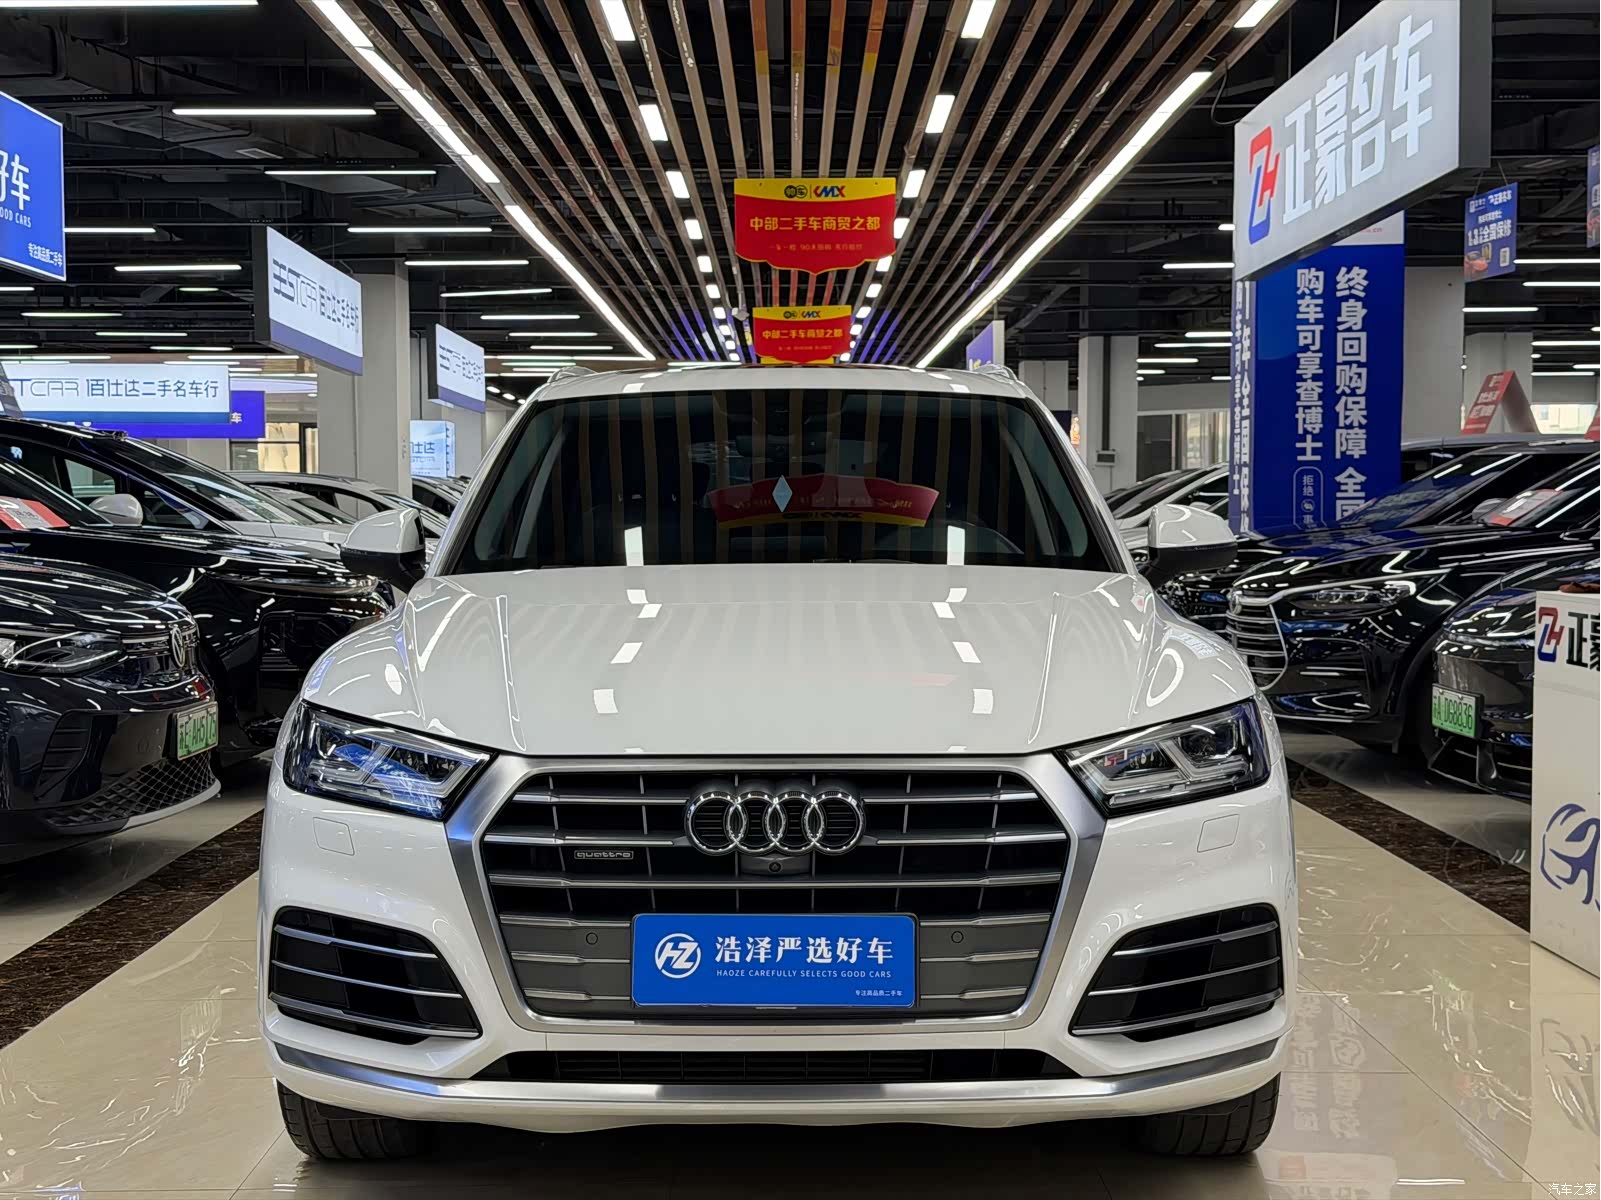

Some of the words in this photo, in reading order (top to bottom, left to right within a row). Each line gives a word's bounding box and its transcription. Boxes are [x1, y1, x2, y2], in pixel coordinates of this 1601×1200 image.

[1283, 15, 1434, 225] 正豪名车
[15, 212, 32, 229] CARS
[750, 216, 881, 231] 中部二手车商贸之都
[762, 328, 844, 339] 中部二手车商贸之都
[1295, 267, 1324, 460] 购车可享查博士
[1335, 266, 1369, 459] 终身回购保障
[86, 378, 219, 398] 佰仕达二手名车行
[715, 936, 894, 965] 浩泽严选好车
[716, 969, 746, 977] HAOZE
[748, 969, 798, 978] CAREFULLY
[800, 969, 838, 978] SELECTS
[840, 970, 866, 978] GOOD
[868, 970, 892, 978] CARS
[855, 989, 903, 997] 专注高品质二手车
